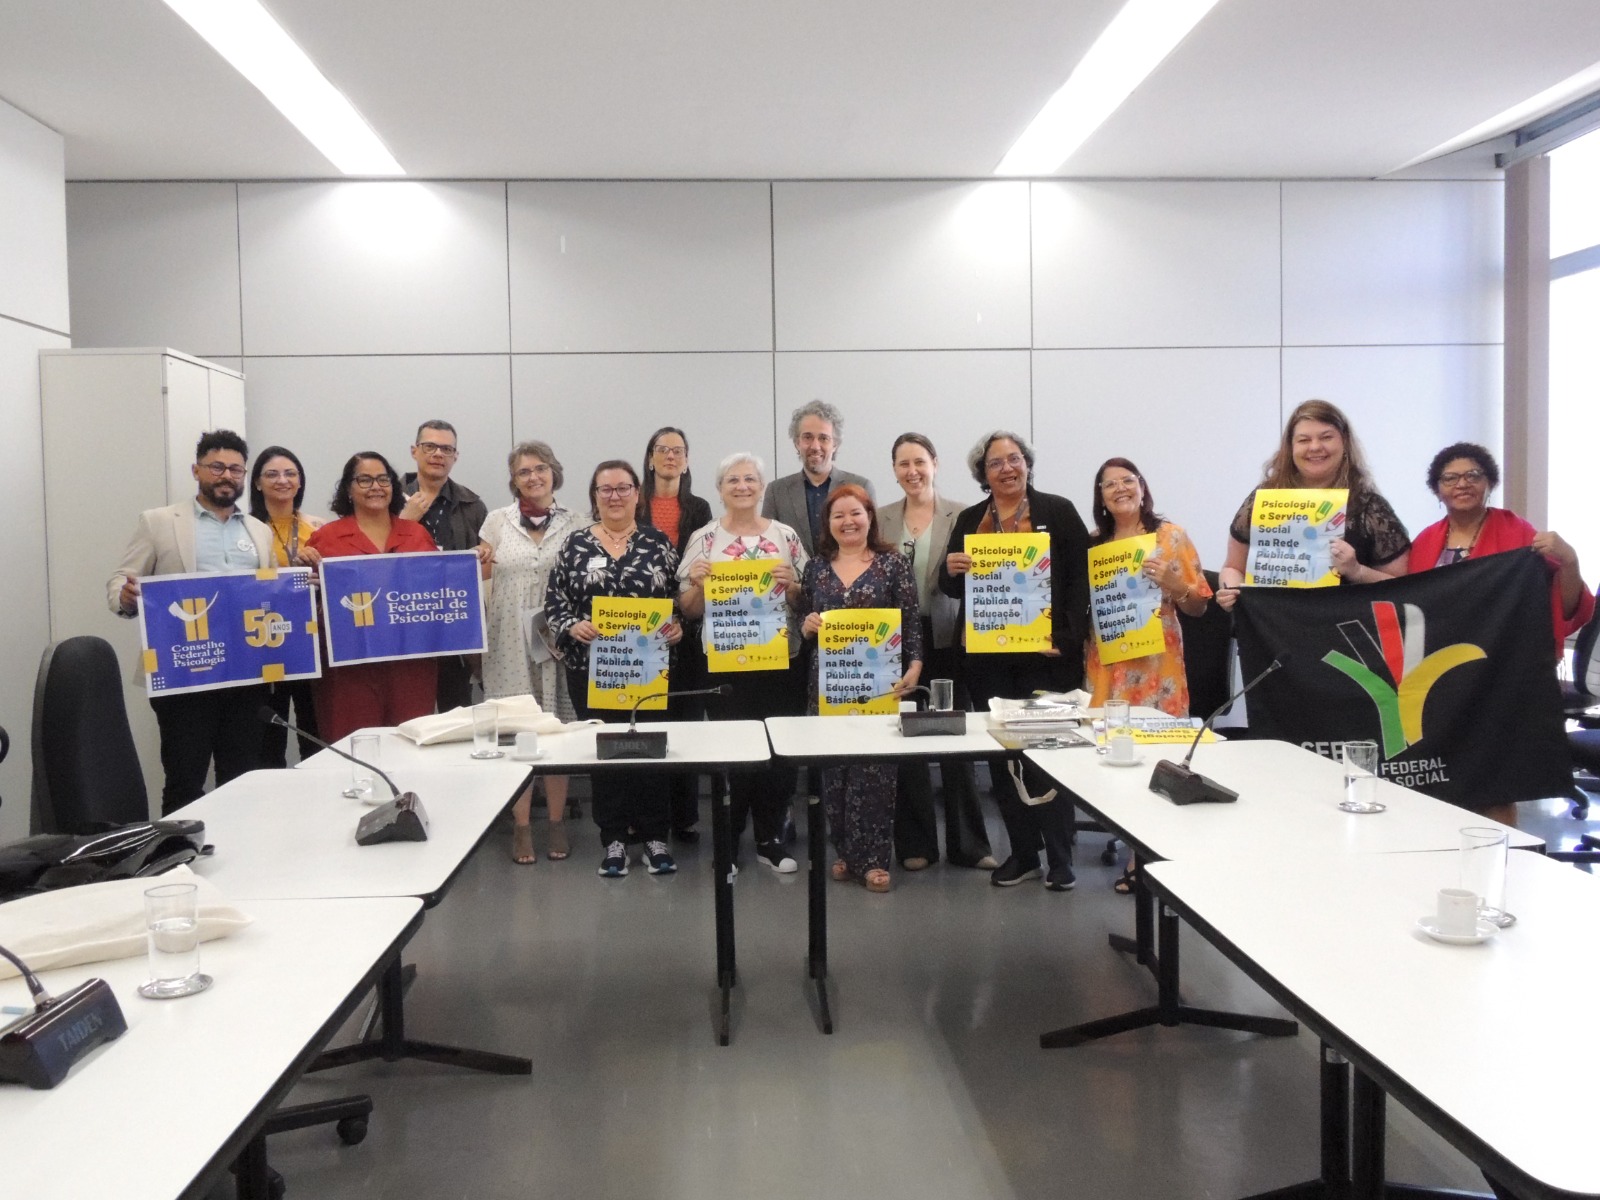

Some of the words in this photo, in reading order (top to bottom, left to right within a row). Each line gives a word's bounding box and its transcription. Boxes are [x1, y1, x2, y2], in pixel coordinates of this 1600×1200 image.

[1262, 500, 1316, 510] Psicologia
[1268, 512, 1308, 523] Serviço
[1258, 524, 1290, 533] Social
[1273, 538, 1299, 548] Rede
[972, 546, 1022, 556] Psicologia
[1256, 550, 1295, 560] Pública
[1298, 552, 1311, 560] de
[980, 559, 1016, 570] Serviço
[1094, 552, 1132, 568] Psicologia
[1100, 566, 1128, 578] Serviço
[1255, 562, 1306, 575] Educação
[711, 572, 758, 582] Psicologia
[972, 572, 1002, 580] Social
[1253, 576, 1288, 586] Básica
[718, 585, 754, 594] Serviço
[1094, 580, 1118, 592] Social
[386, 588, 467, 602] Conselho
[1106, 592, 1126, 603] Rede
[388, 599, 444, 613] Federal
[449, 598, 467, 609] de
[712, 598, 740, 606] Social
[973, 597, 1009, 605] Pública
[599, 609, 646, 620] Psicologia
[973, 609, 1020, 620] Educação
[1096, 604, 1126, 618] Pública
[1127, 602, 1137, 610] de
[388, 609, 468, 624] Psicologia
[606, 622, 640, 632] Serviço
[713, 620, 747, 628] Pública
[825, 622, 874, 631] Psicologia
[973, 622, 1005, 630] Básica
[1100, 615, 1135, 630] Educação
[244, 609, 284, 648] 50
[272, 624, 290, 632] ANOS
[598, 634, 626, 642] Social
[714, 630, 758, 640] Educação
[833, 634, 869, 644] Serviço
[1101, 631, 1124, 642] Básica
[171, 641, 225, 652] Conselho
[610, 646, 633, 654] Rede
[826, 647, 854, 655] Social
[173, 650, 210, 660] Federal
[213, 648, 225, 656] de
[174, 656, 226, 667] Psicologia
[596, 657, 631, 666] Pública
[633, 658, 644, 666] de
[596, 668, 640, 680] Educação
[826, 671, 861, 679] Pública
[596, 680, 626, 689] Básica
[826, 683, 872, 694] Educação
[826, 696, 856, 704] Básica
[1381, 757, 1446, 775] FEDERAL
[1396, 770, 1449, 787] SOCIAL
